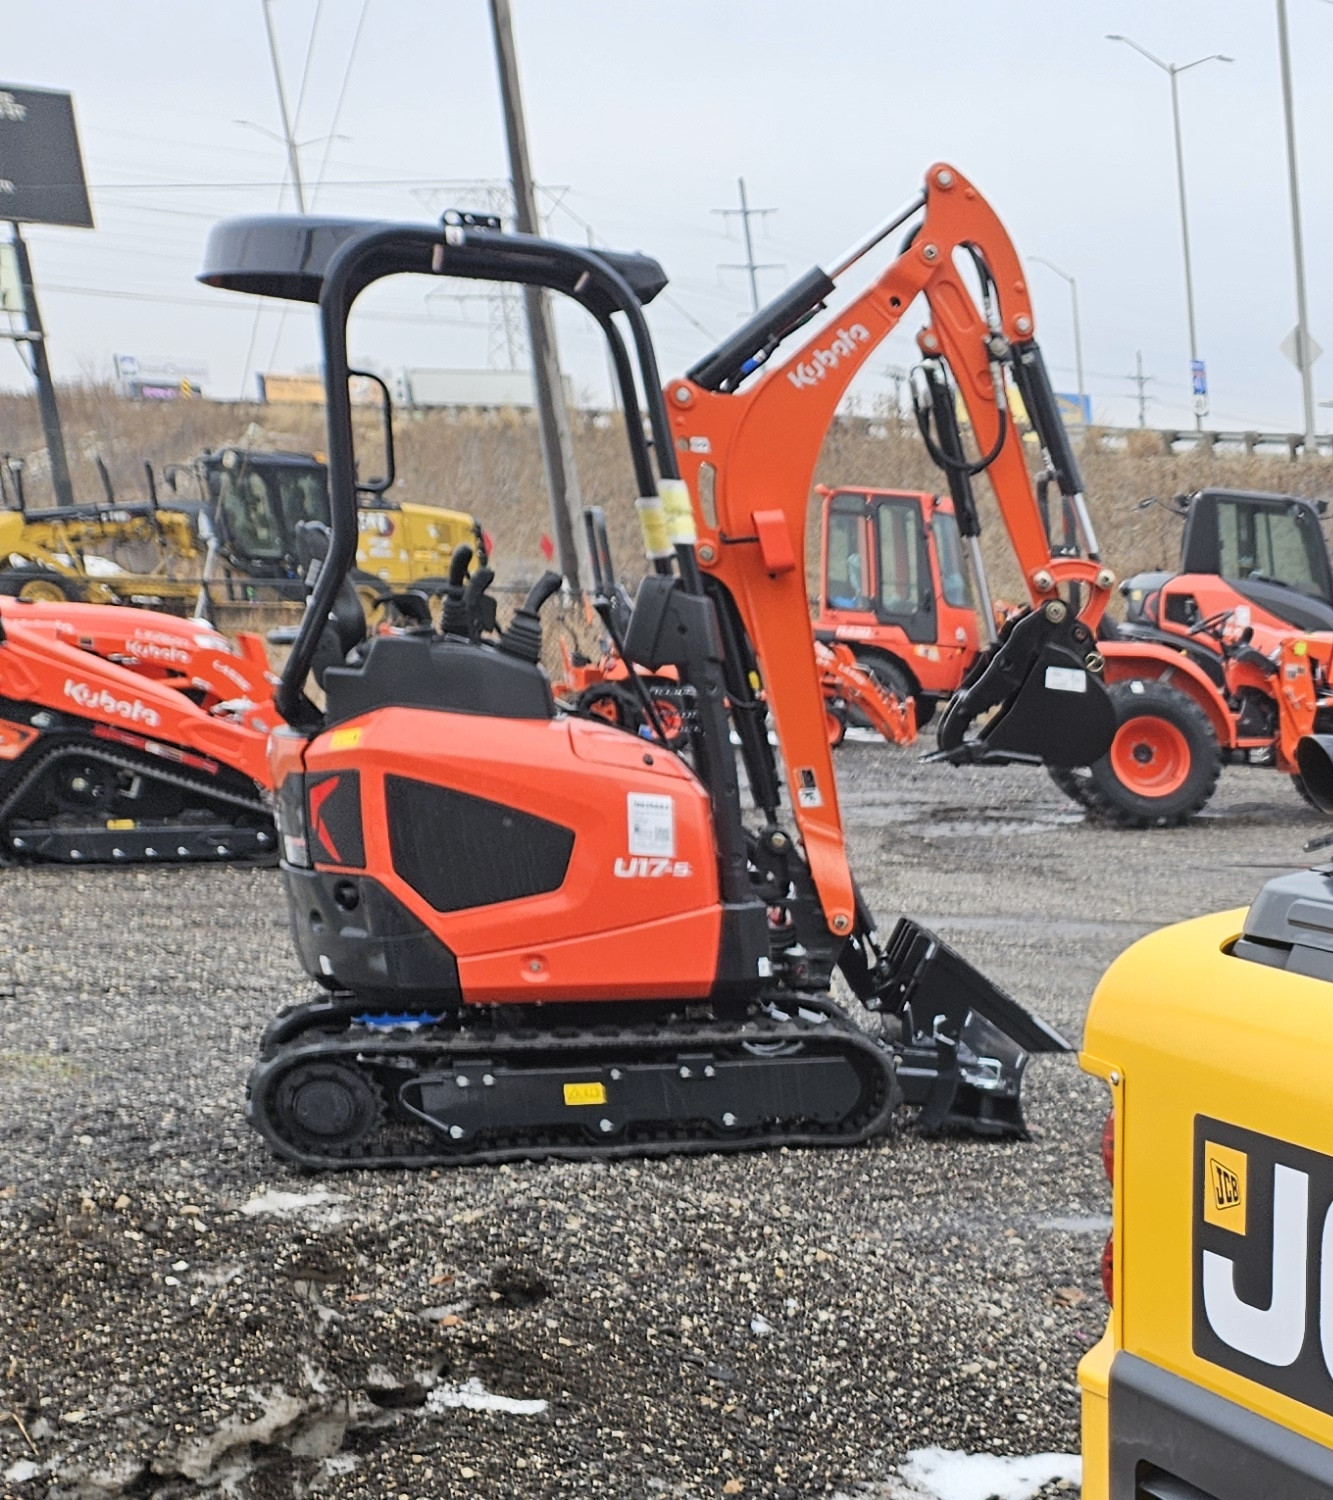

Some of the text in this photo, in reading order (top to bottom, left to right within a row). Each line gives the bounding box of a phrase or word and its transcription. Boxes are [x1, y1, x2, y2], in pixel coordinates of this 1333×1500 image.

[787, 323, 871, 390] Kubota
[64, 678, 161, 727] Kubota
[1215, 1166, 1241, 1206] JCB
